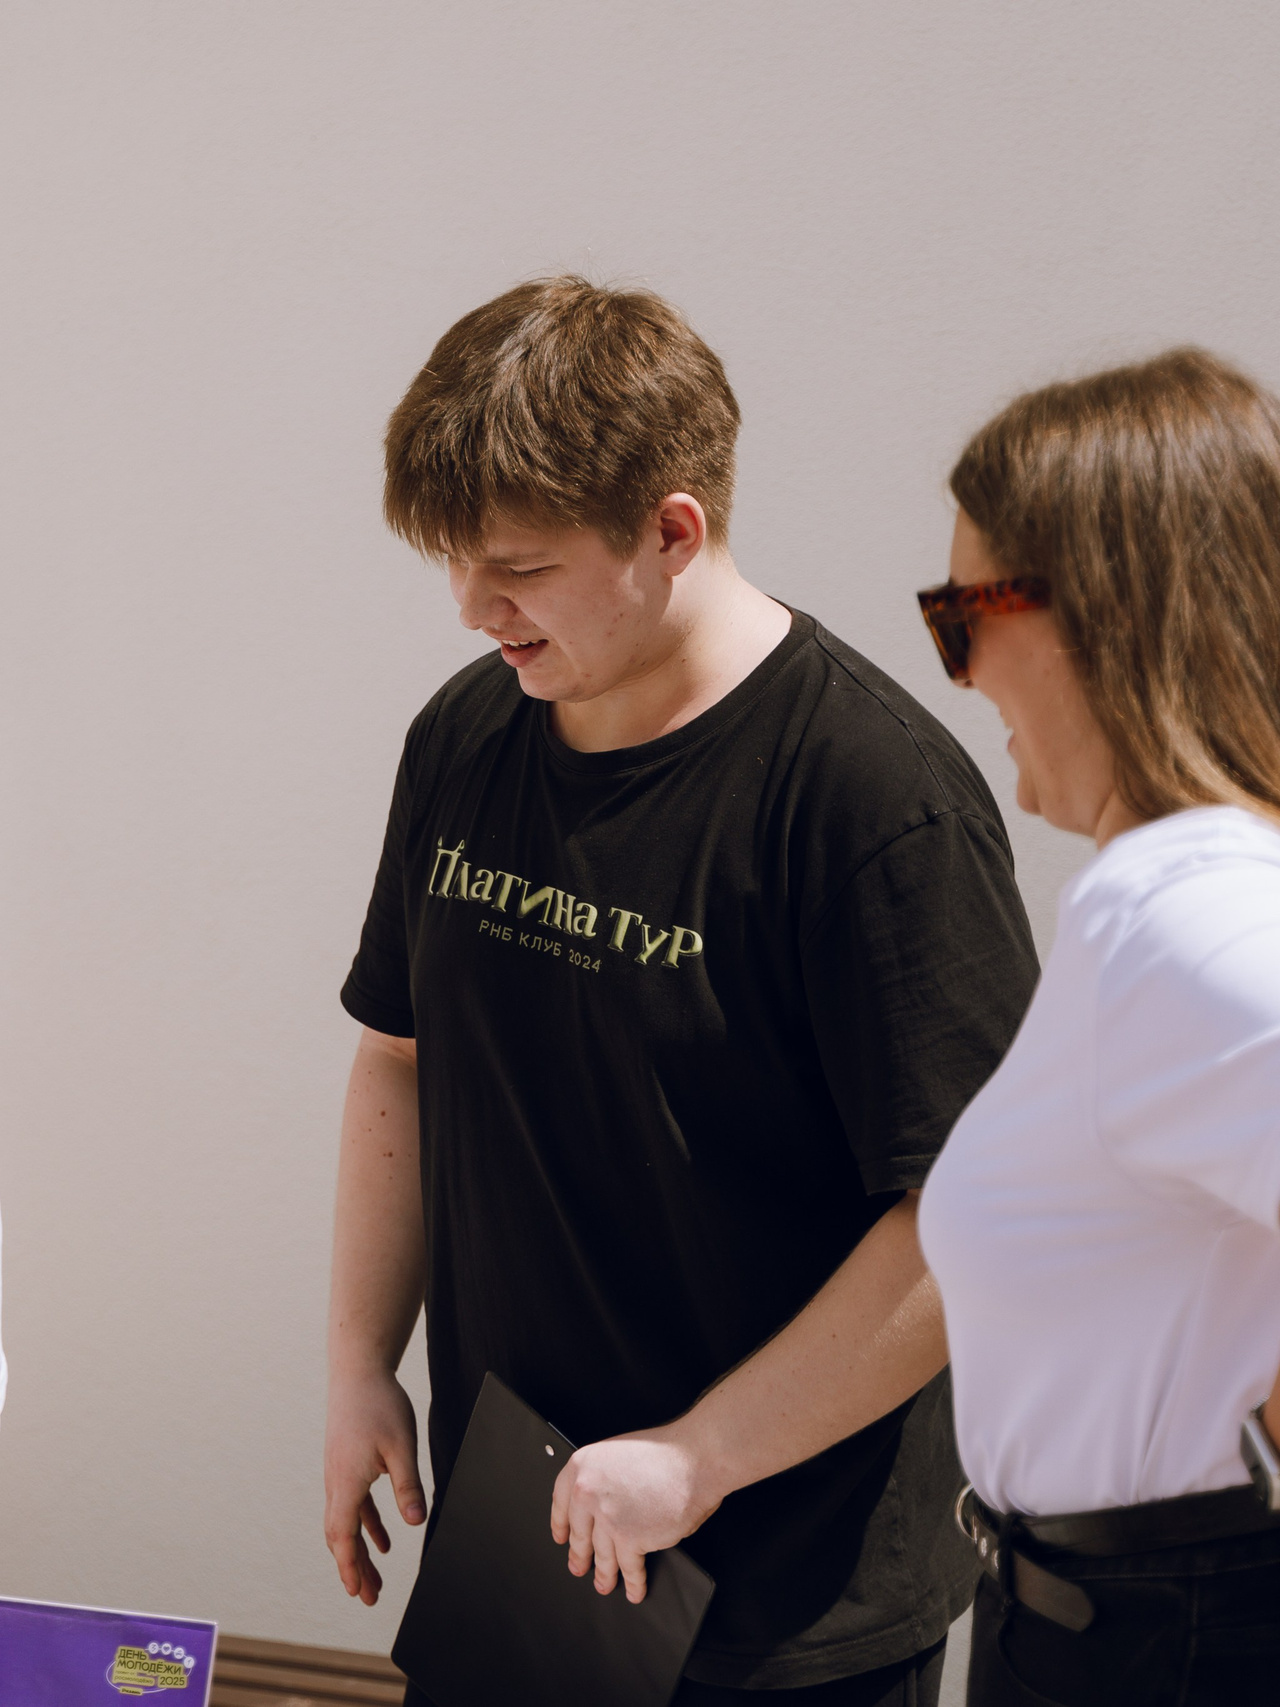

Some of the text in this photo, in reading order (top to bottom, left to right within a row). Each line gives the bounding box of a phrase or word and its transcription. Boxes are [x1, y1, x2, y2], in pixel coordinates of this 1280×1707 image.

[478, 919, 601, 973] РНБ КЛУБ 2024
[118, 1649, 147, 1661] ДЕНЬ
[117, 1660, 182, 1676] МОЛОДЁЖИ
[160, 1676, 185, 1687] 2025
